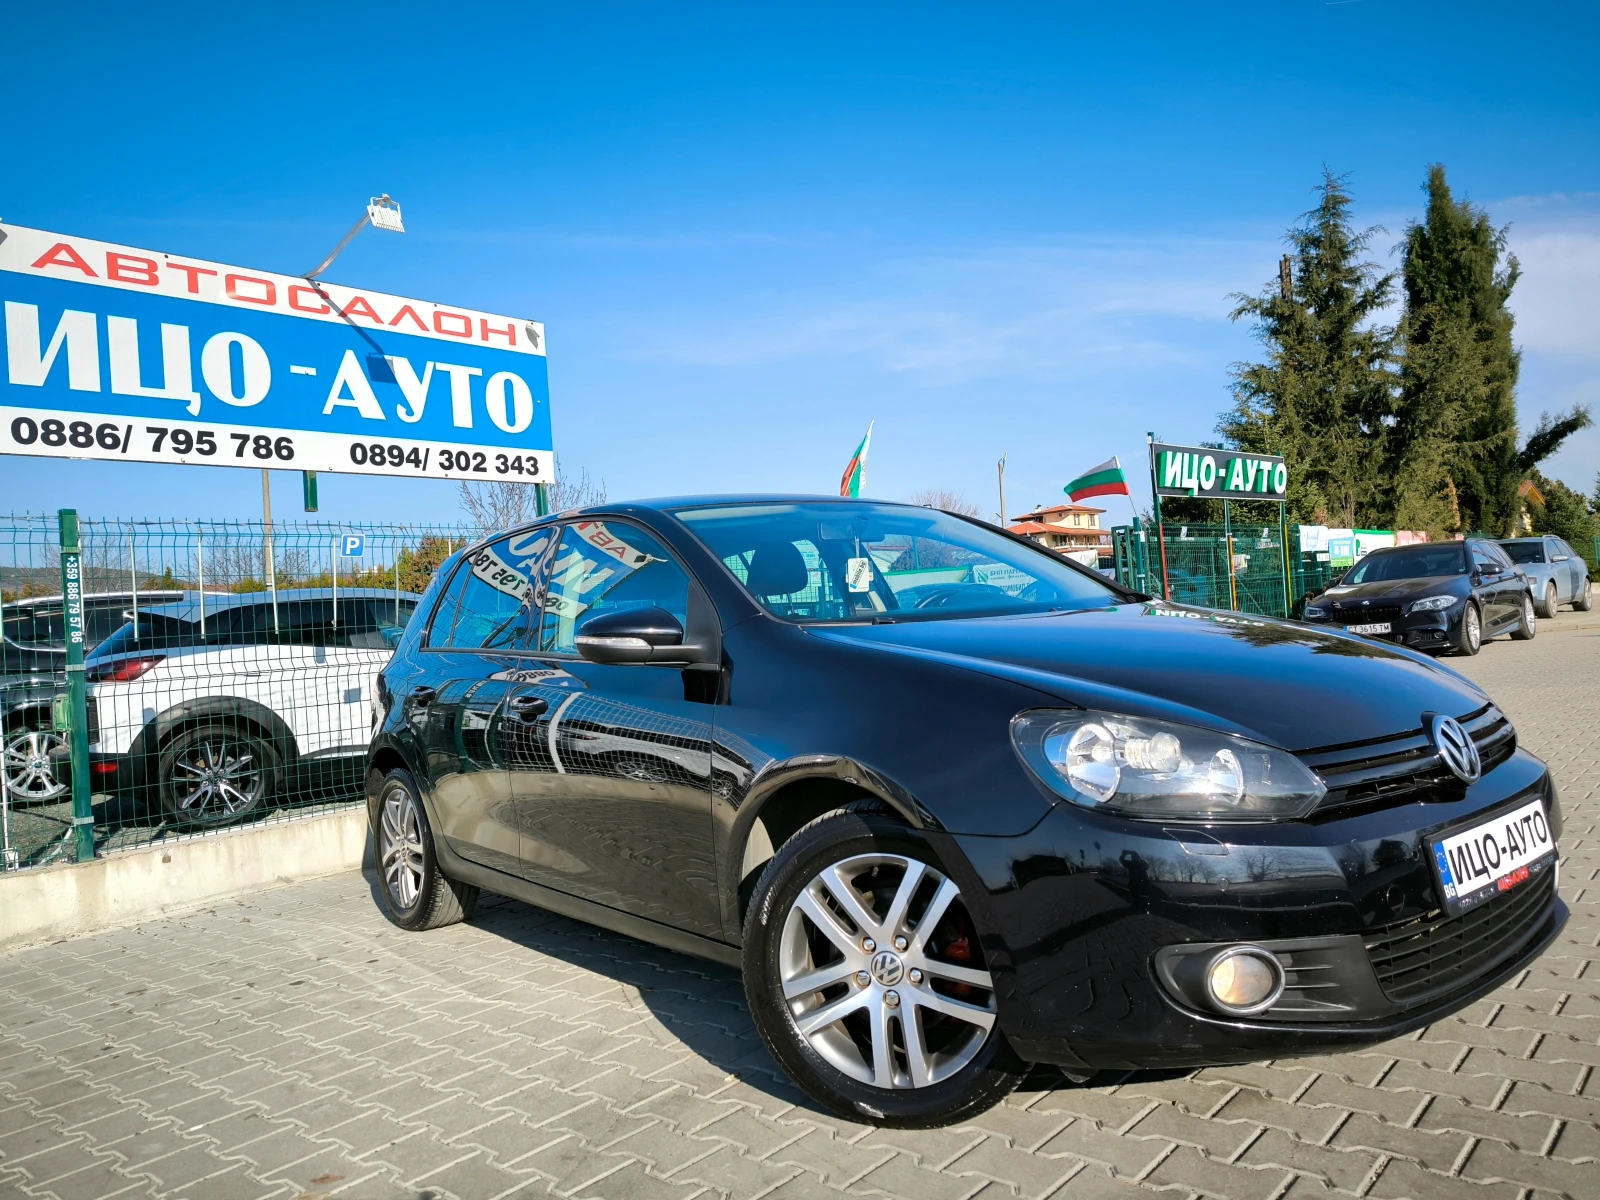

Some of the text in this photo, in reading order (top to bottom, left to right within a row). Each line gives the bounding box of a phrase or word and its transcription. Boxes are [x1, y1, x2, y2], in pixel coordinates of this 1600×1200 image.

[30, 242, 517, 346] АВТОСАЛОН
[10, 416, 539, 476] 0886/ 795 786 0894/ 302 343
[1160, 451, 1287, 496] ИЦО-АУТО
[345, 537, 360, 555] P
[66, 556, 82, 643] +359 886 79 57 86
[1360, 625, 1378, 633] 3615
[1379, 624, 1390, 632] TM
[1448, 810, 1548, 886] ИЦО-АУТО
[1443, 882, 1457, 899] BG
